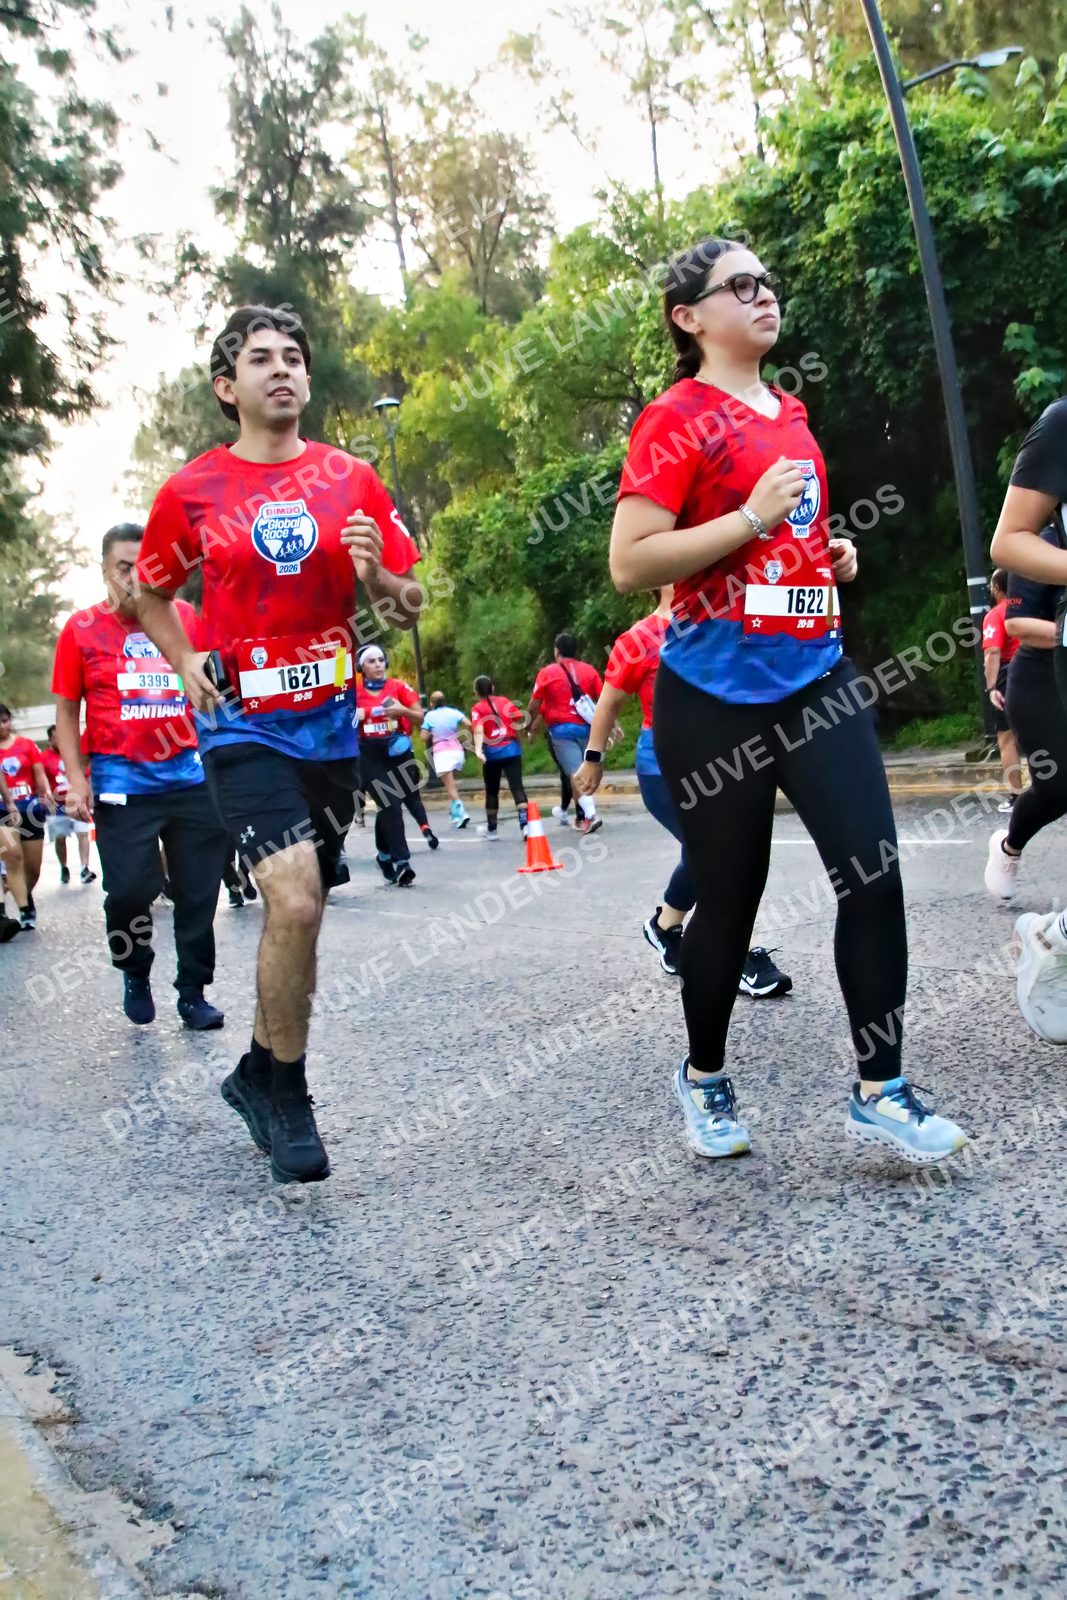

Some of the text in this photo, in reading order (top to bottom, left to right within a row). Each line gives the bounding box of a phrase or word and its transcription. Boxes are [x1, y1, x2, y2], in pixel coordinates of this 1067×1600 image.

[265, 506, 301, 516] BIMBO
[267, 516, 302, 530] Global
[261, 528, 290, 540] Race
[278, 564, 299, 574] 2026
[787, 588, 824, 614] 1622
[138, 674, 170, 688] 3399
[277, 663, 321, 691] 1621
[292, 690, 313, 702] 20-26
